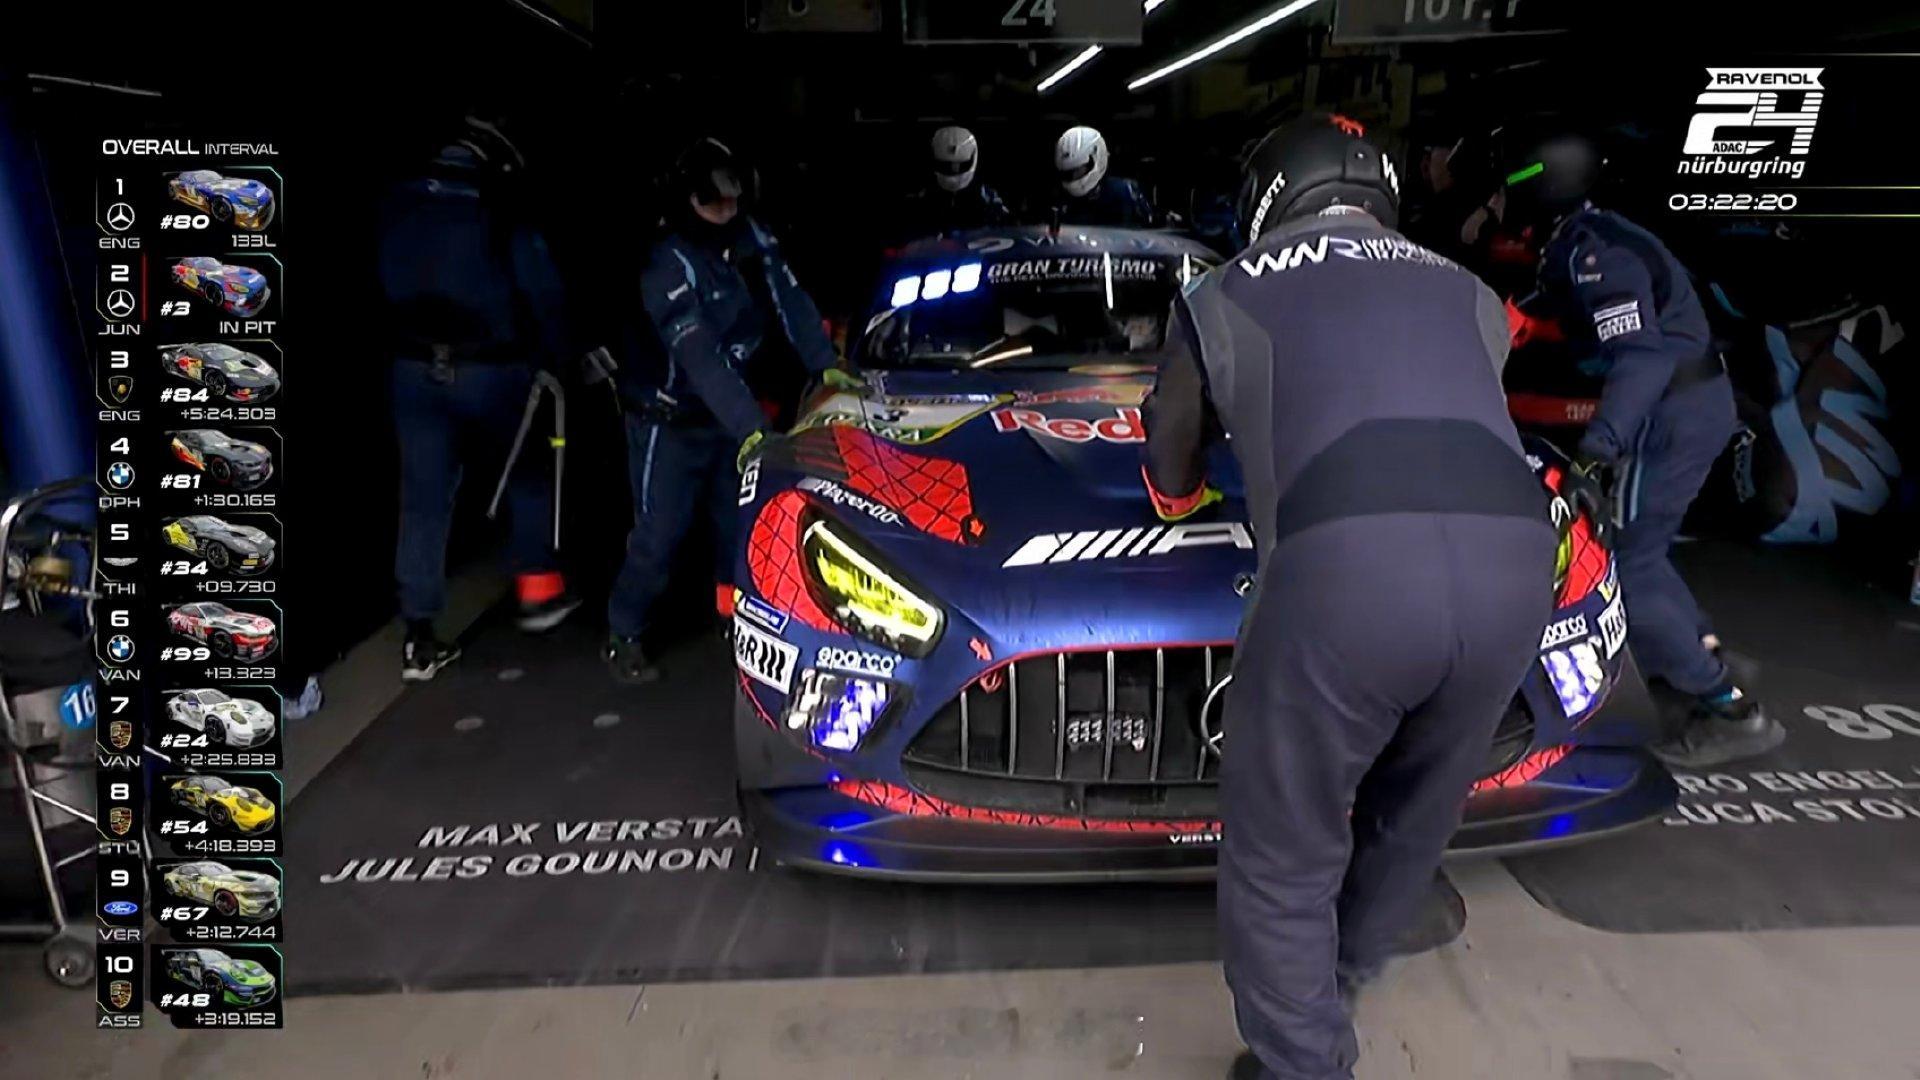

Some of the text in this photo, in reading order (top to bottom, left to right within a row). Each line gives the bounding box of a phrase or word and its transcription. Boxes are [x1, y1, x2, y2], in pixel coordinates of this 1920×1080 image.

[1058, 258, 1156, 273] TURSMO
[991, 408, 1147, 443] Red
[418, 816, 744, 848] MAX VERSTA
[319, 846, 735, 884] JULES GOUNON
